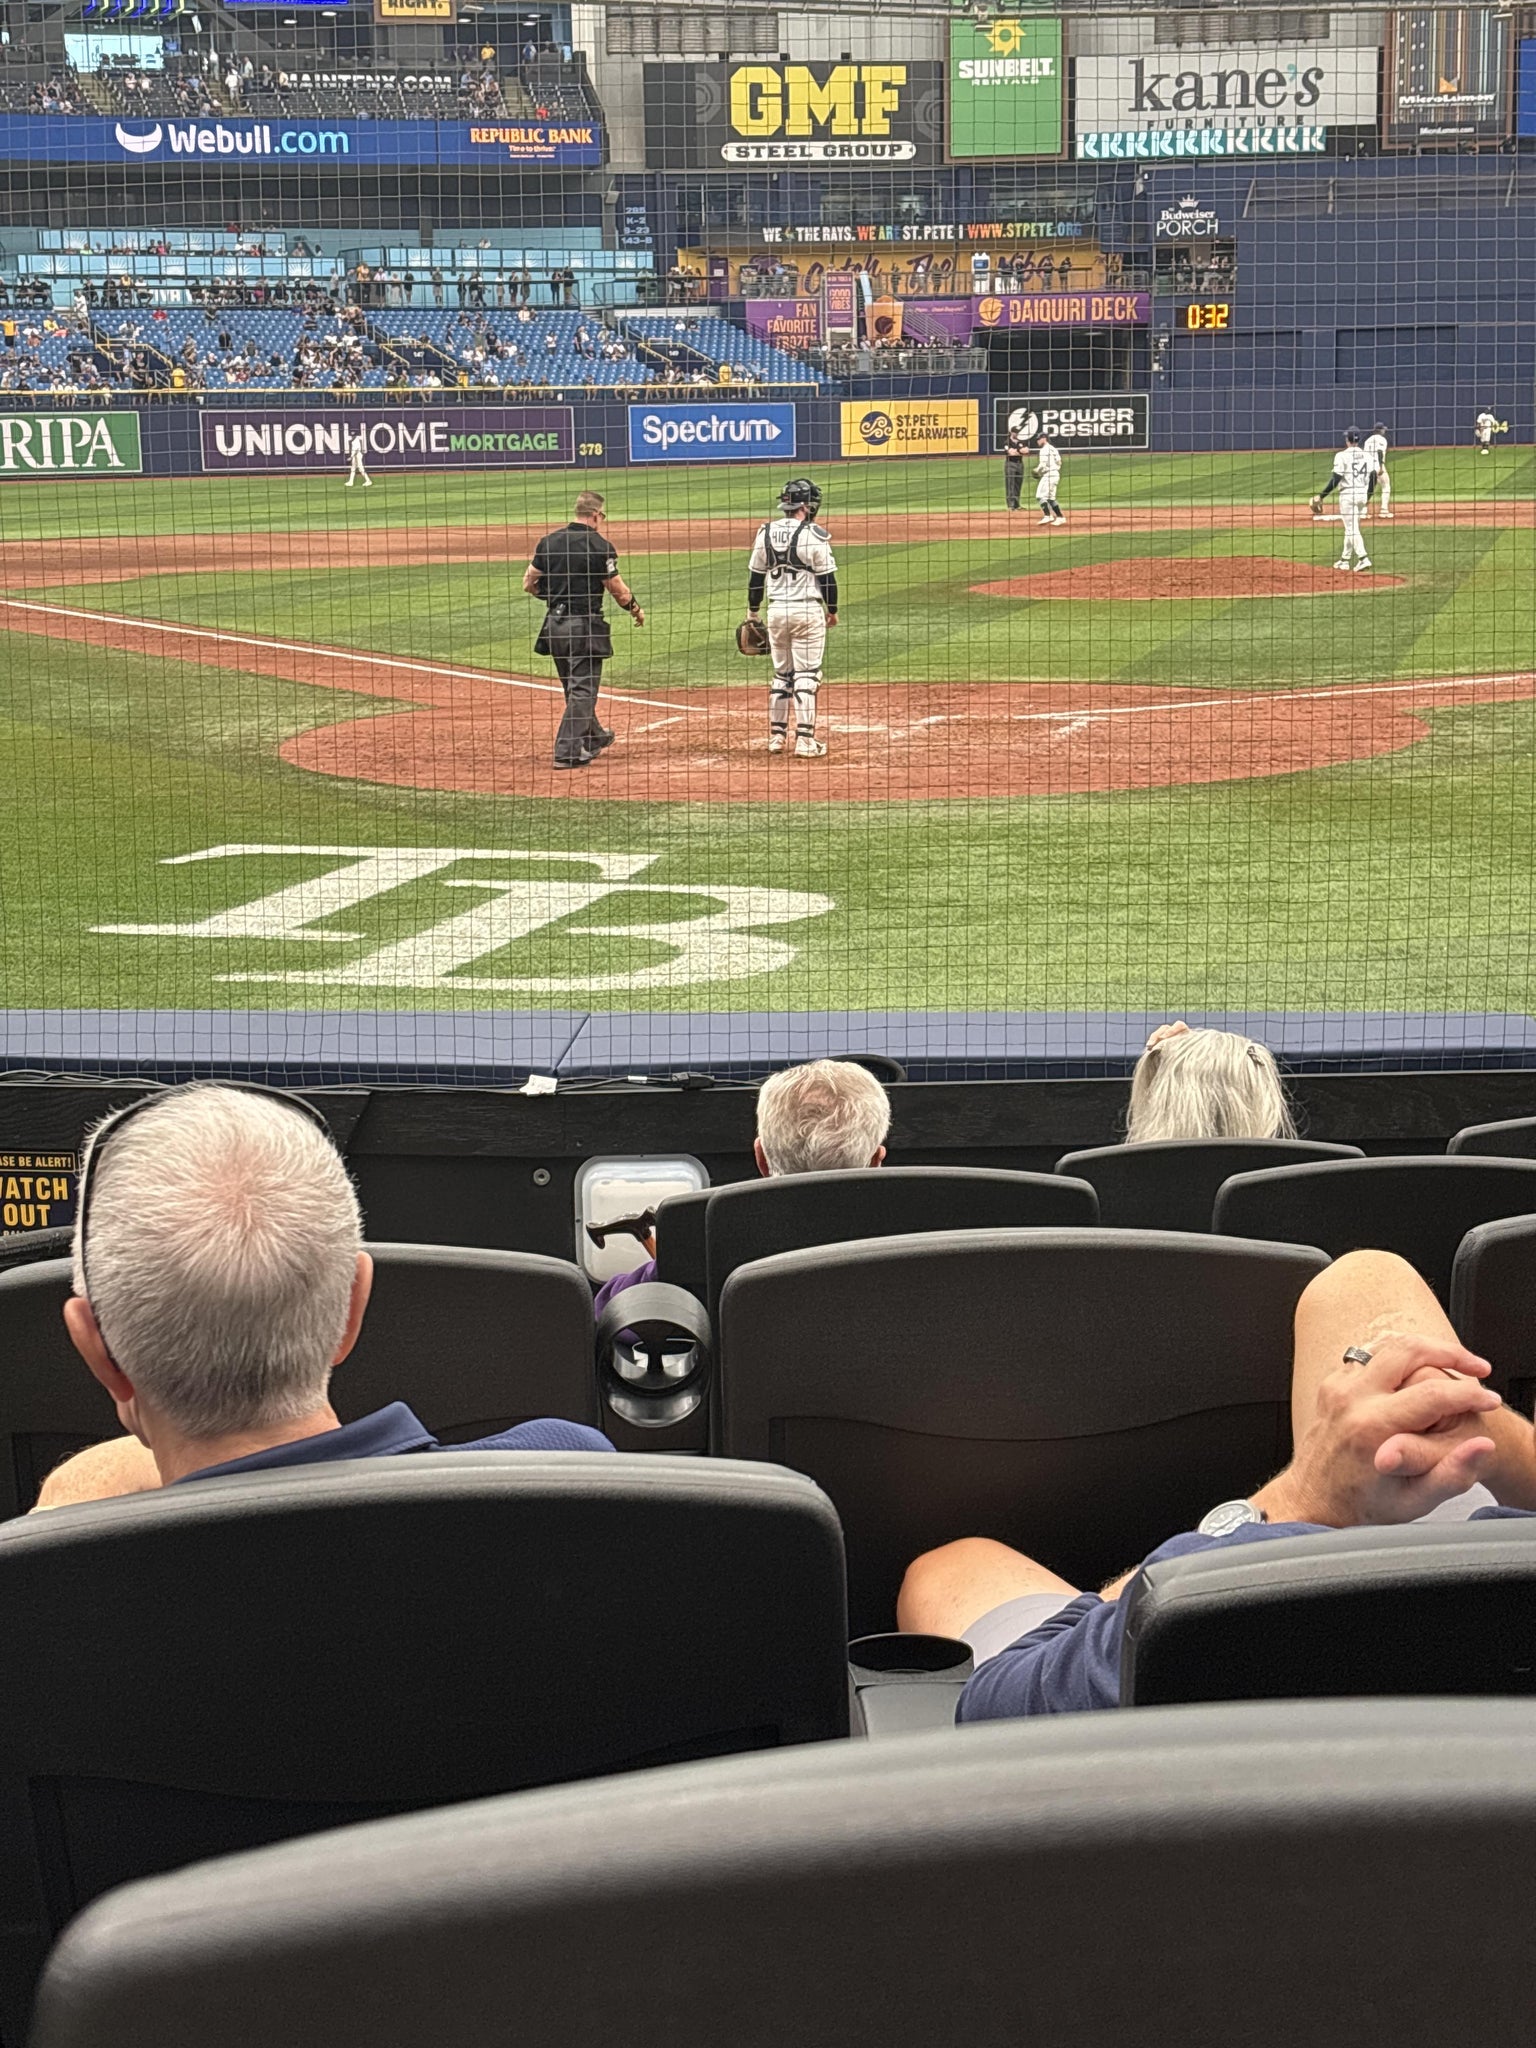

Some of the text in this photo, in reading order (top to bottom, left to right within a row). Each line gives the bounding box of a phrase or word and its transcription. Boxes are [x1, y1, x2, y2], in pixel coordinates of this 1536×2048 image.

[1128, 57, 1325, 112] kane's
[730, 66, 907, 136] GMF
[1147, 115, 1305, 130] FURNITURE
[168, 124, 349, 154] Webull.com
[470, 128, 593, 144] REPUBLIC BANK
[736, 144, 903, 158] STEEL GROUP
[1161, 210, 1216, 221] Budweiser
[763, 227, 783, 242] WE
[796, 227, 820, 241] THE
[857, 225, 876, 241] WE
[878, 225, 900, 240] ARE
[967, 222, 1083, 239] WWW.STPETE.ORG
[1156, 219, 1219, 237] PORCH
[796, 303, 817, 318] FAN
[1009, 296, 1138, 323] DAIQUIRI DECK
[1188, 304, 1229, 329] 0:32
[767, 319, 817, 333] FAVORITE
[643, 415, 774, 450] Spectrum
[896, 427, 968, 441] CLEARWATER
[0, 417, 125, 469] RIPA
[450, 433, 559, 452] MORTGAGE
[579, 443, 603, 456] 378
[1352, 462, 1368, 478] 54
[19, 1156, 32, 1167] BE
[35, 1157, 71, 1168] ALERT!
[0, 1176, 69, 1200] ATCH
[3, 1203, 51, 1227] OUT
